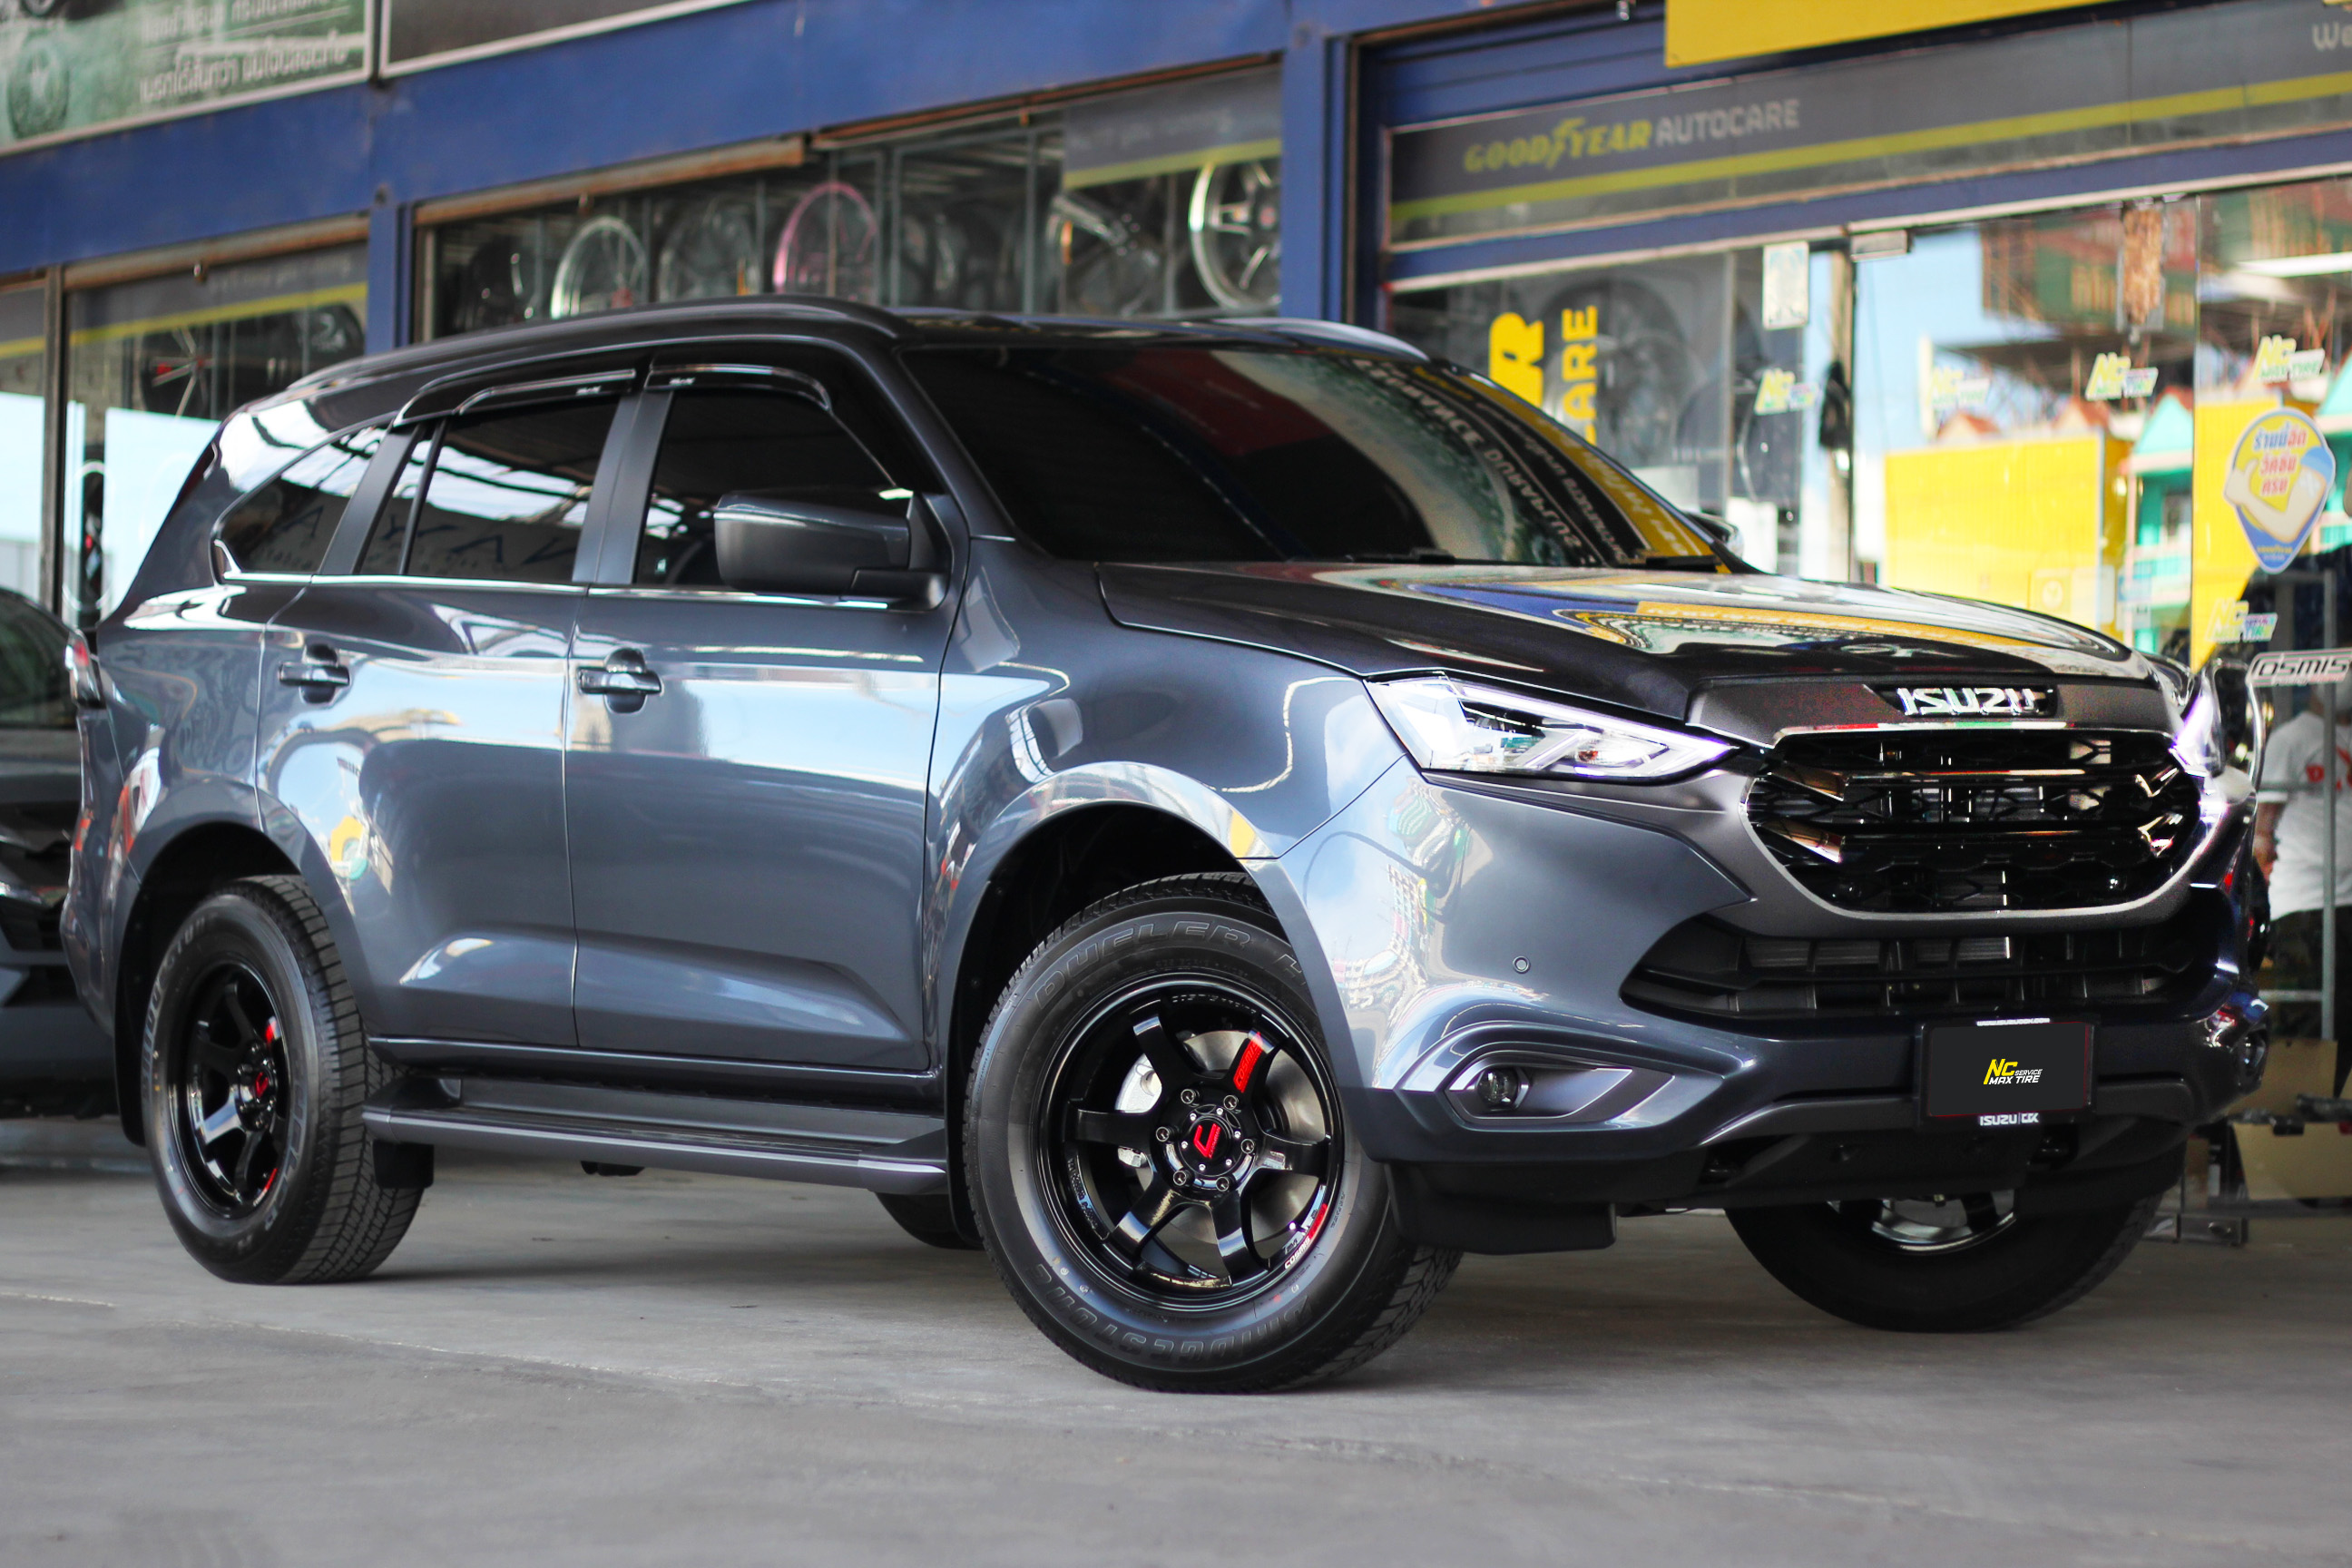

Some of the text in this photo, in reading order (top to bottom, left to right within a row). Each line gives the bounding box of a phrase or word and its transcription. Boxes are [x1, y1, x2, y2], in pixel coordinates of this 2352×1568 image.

[1463, 99, 1800, 172] GOODYEAR AUTOCARE
[1896, 687, 2042, 715] ISUZU
[1034, 920, 1252, 1009] DUELER
[1980, 1114, 2017, 1125] ISUZU
